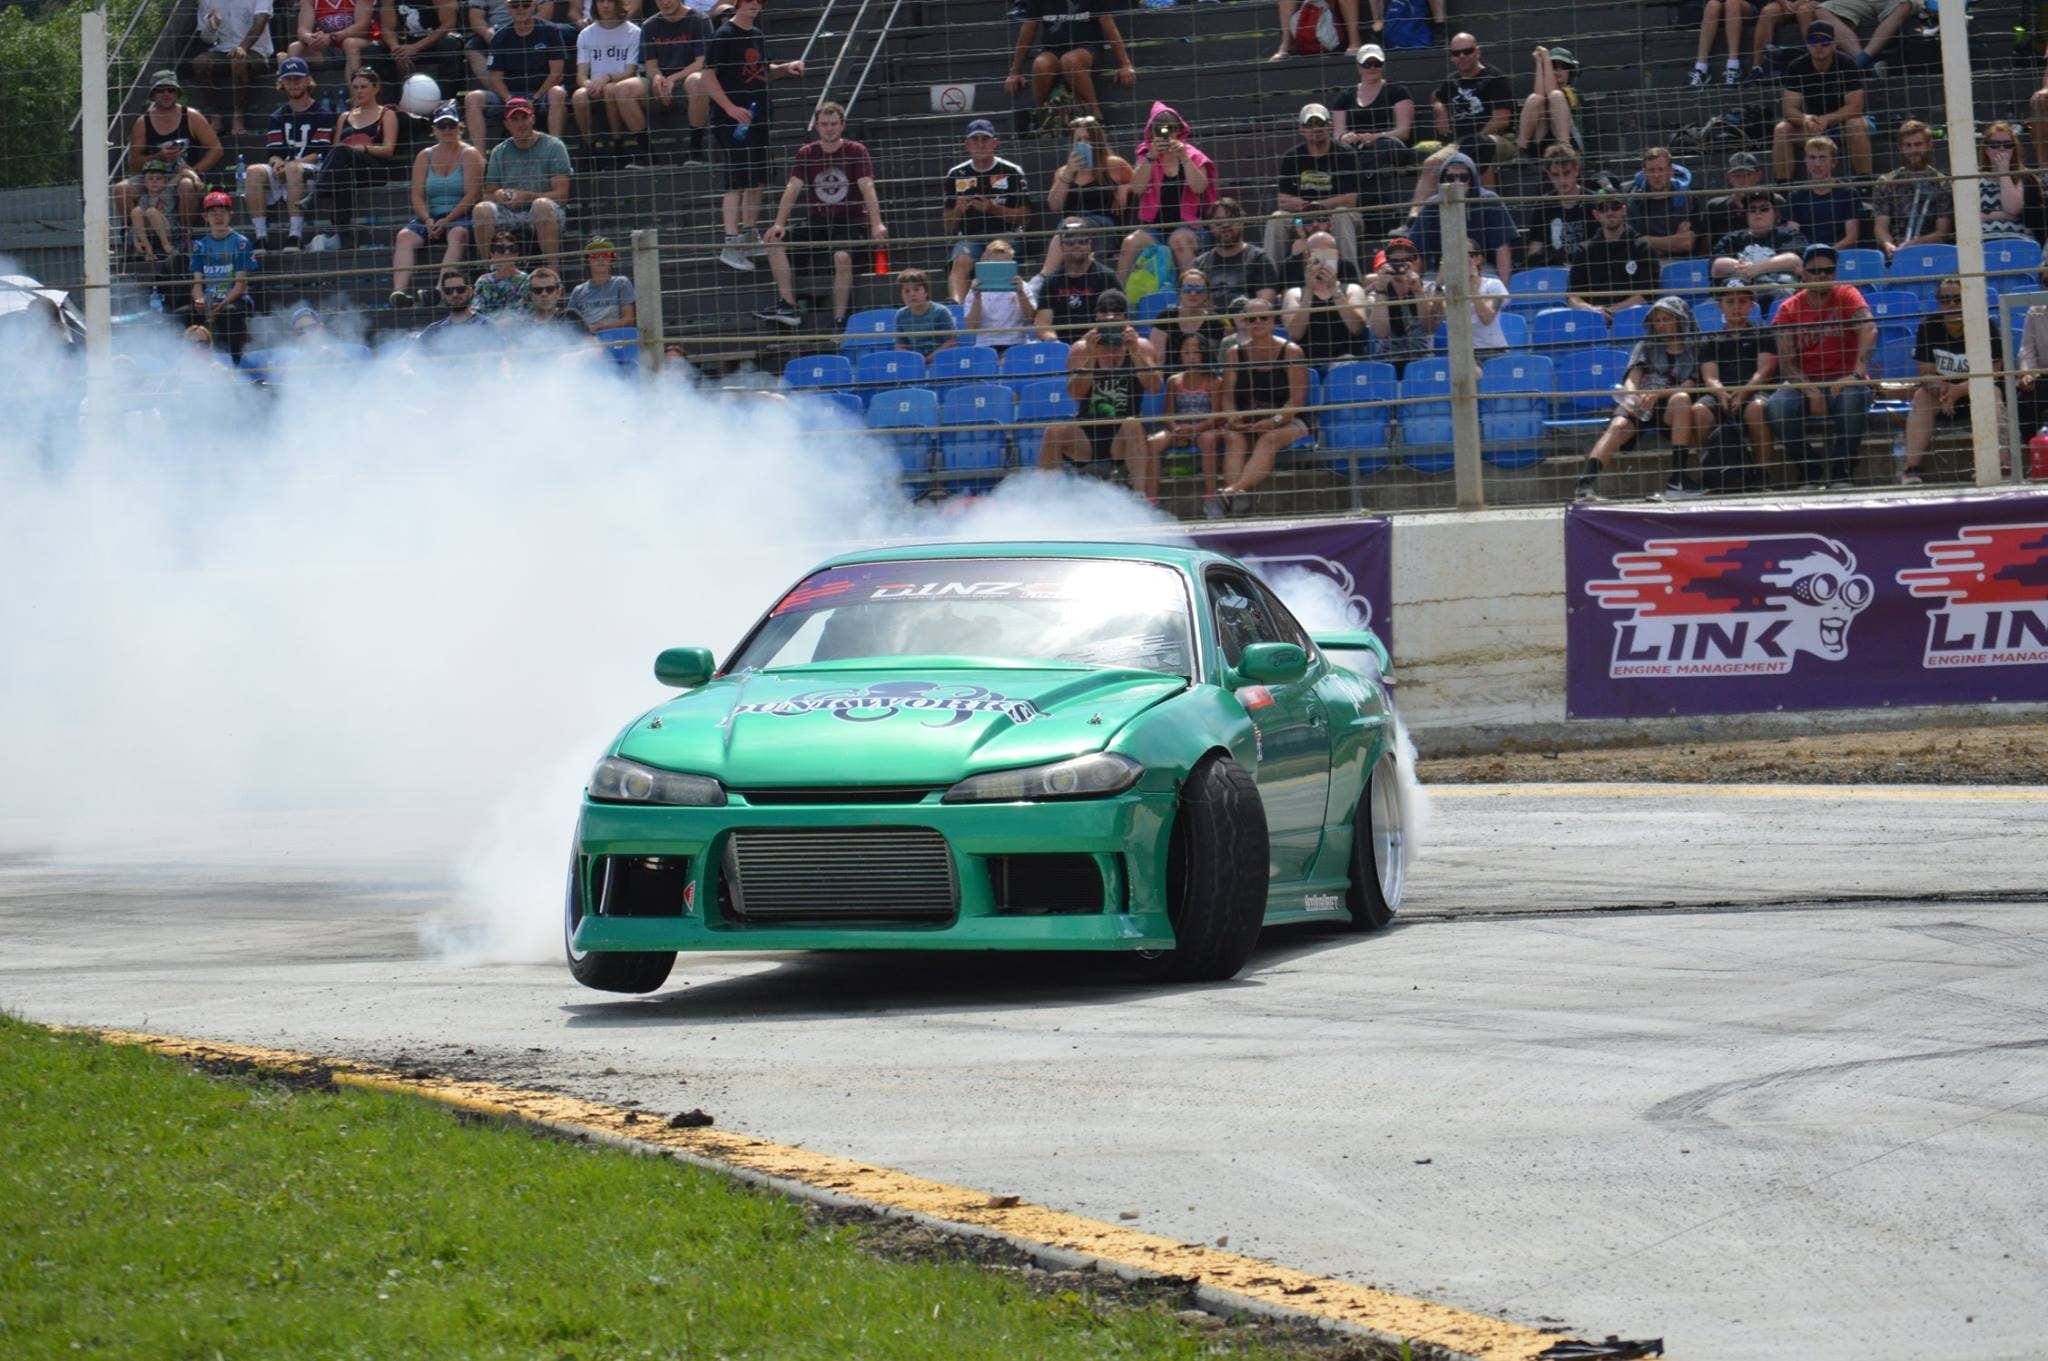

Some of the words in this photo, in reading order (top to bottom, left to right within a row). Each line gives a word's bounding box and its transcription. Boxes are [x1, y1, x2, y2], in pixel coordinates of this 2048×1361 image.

[592, 48, 602, 61] it
[870, 581, 1024, 598] D1NZ
[1615, 619, 1795, 662] LINK
[1928, 654, 1986, 666] ENGINE
[1613, 665, 1673, 676] ENGINE
[1676, 661, 1788, 674] MANAGEMENT
